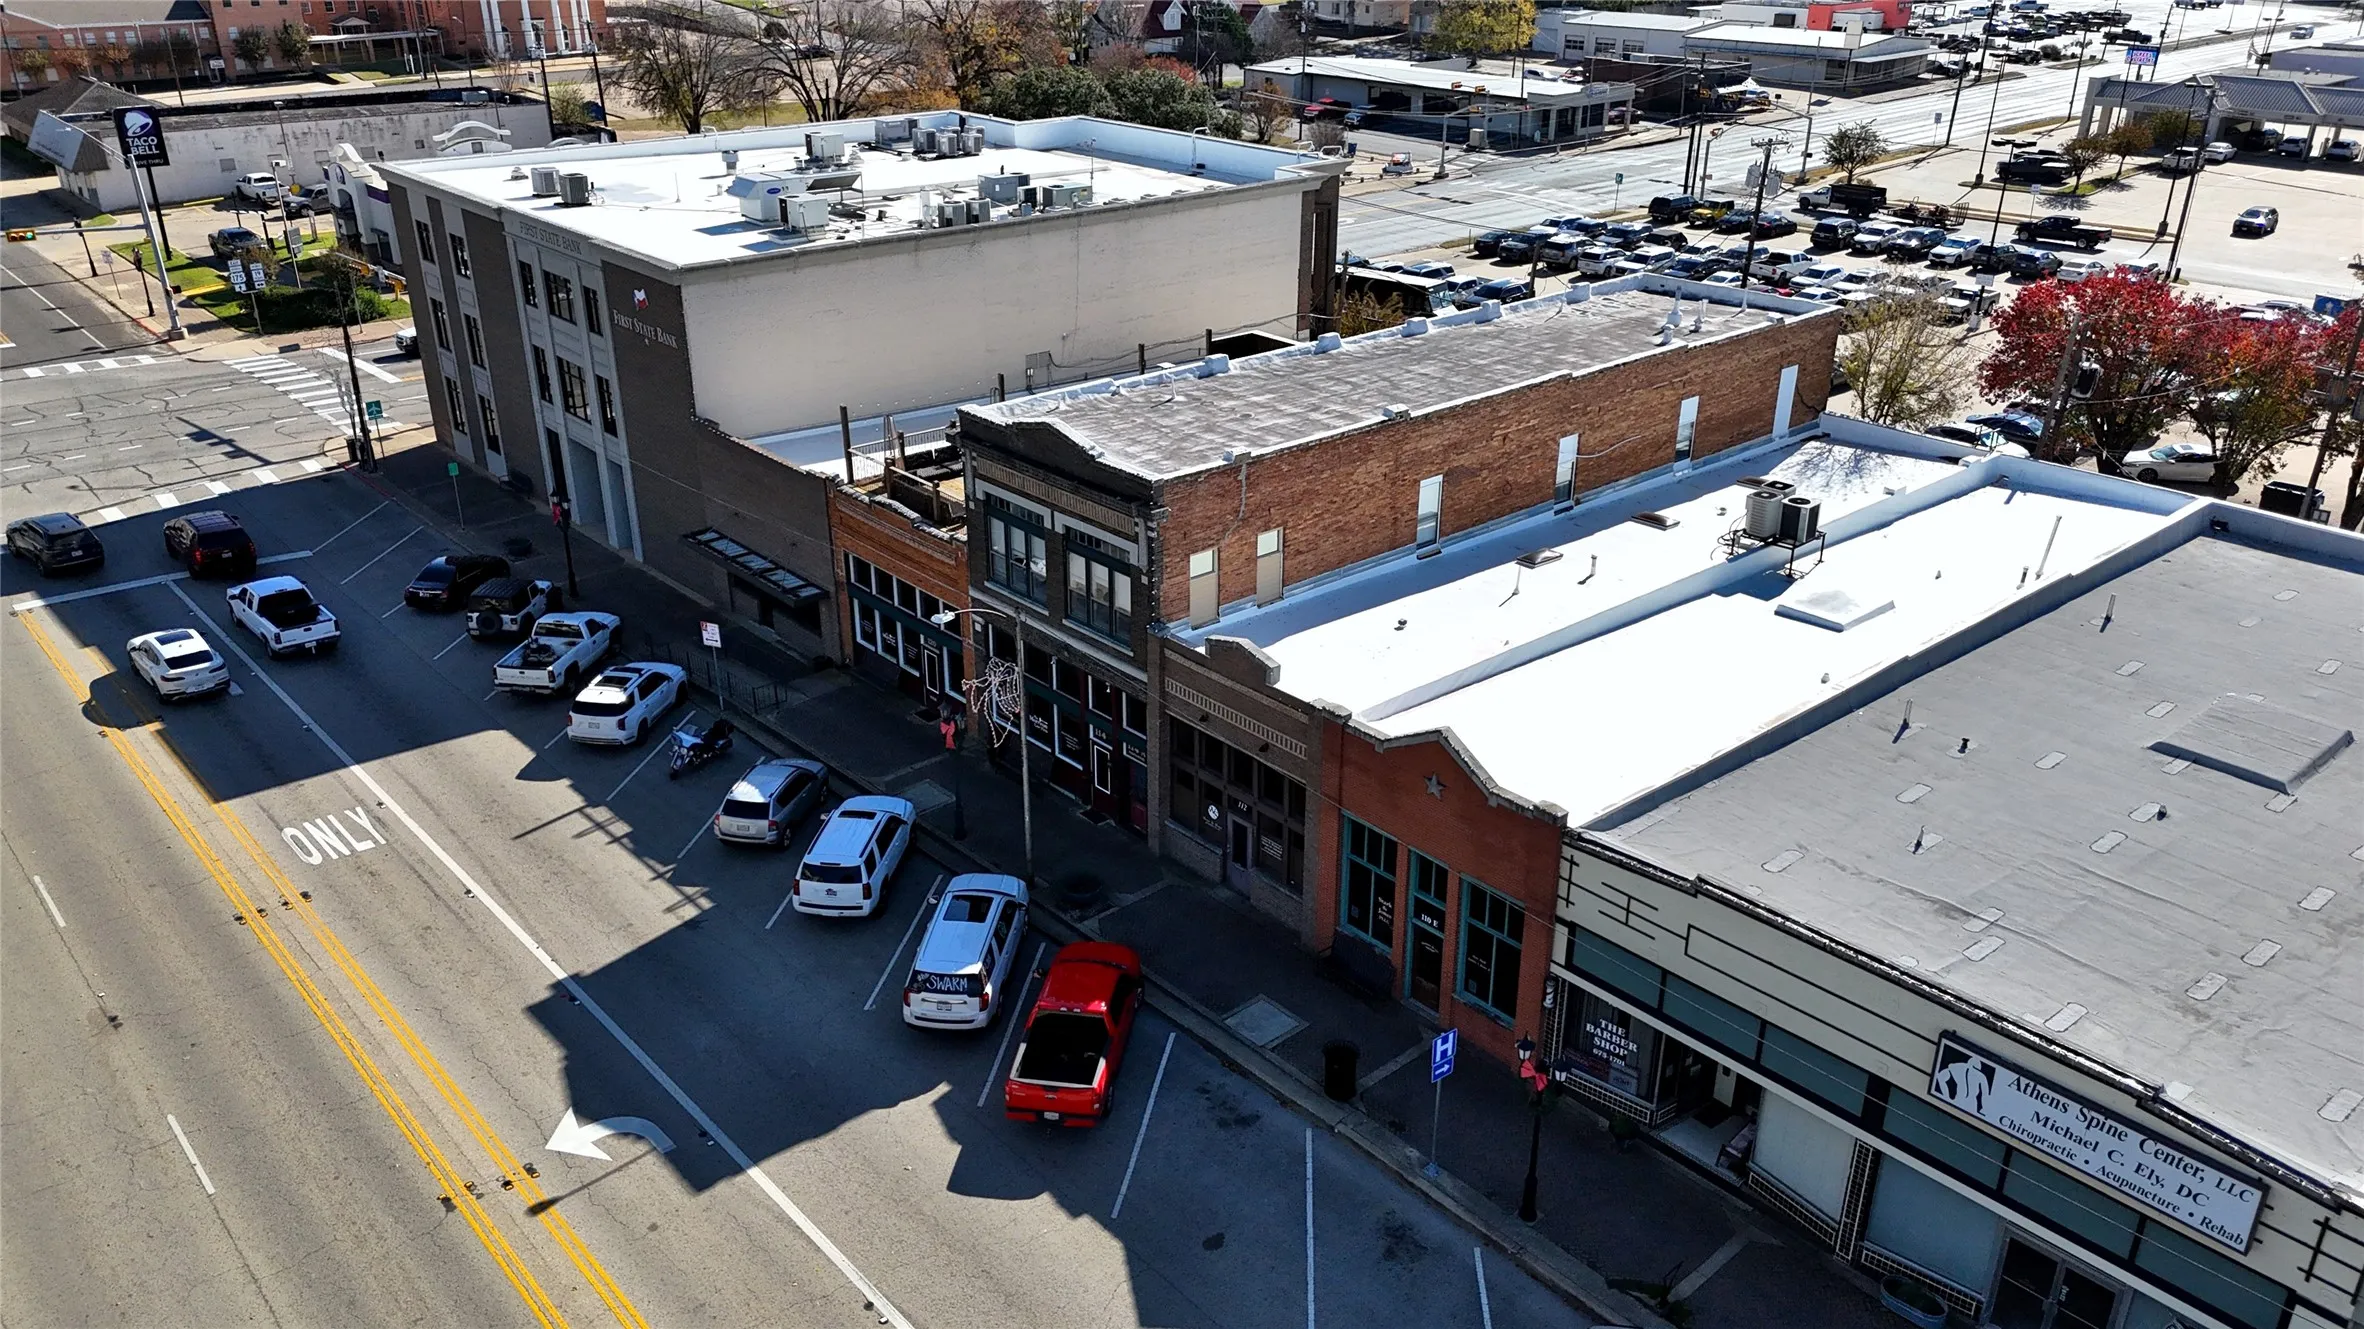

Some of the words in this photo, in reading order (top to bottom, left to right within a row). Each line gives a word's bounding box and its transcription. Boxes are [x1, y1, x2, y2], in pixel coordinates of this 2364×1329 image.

[126, 136, 158, 147] TACO
[130, 145, 160, 156] BELL
[519, 220, 538, 239] FIRST
[539, 227, 561, 247] STATE
[561, 236, 582, 255] BANK
[231, 273, 245, 282] 175
[612, 309, 633, 330] FIRST
[633, 318, 657, 340] STATE
[656, 326, 679, 350] BANK
[281, 806, 387, 865] ONLY
[1420, 913, 1432, 924] 110
[1433, 919, 1439, 928] E
[926, 975, 968, 992] SWARM
[1585, 1022, 1638, 1053] BARBER
[1599, 1018, 1627, 1037] THE
[1435, 1032, 1454, 1063] H
[1592, 1047, 1626, 1067] 675-1701
[1593, 1036, 1629, 1057] SHOP
[2008, 1074, 2070, 1114] Athens
[2075, 1105, 2129, 1143] Spine
[2138, 1136, 2206, 1185] Center,
[2214, 1177, 2255, 1204] LLC
[2030, 1110, 2100, 1153] Michael
[2106, 1148, 2126, 1167] C.
[2133, 1161, 2166, 1189] Ely,
[2175, 1182, 2211, 1208] DC
[1998, 1115, 2078, 1162] Chiropractic
[2094, 1164, 2181, 1214] Acupuncture
[2198, 1215, 2245, 1247] Rehab
